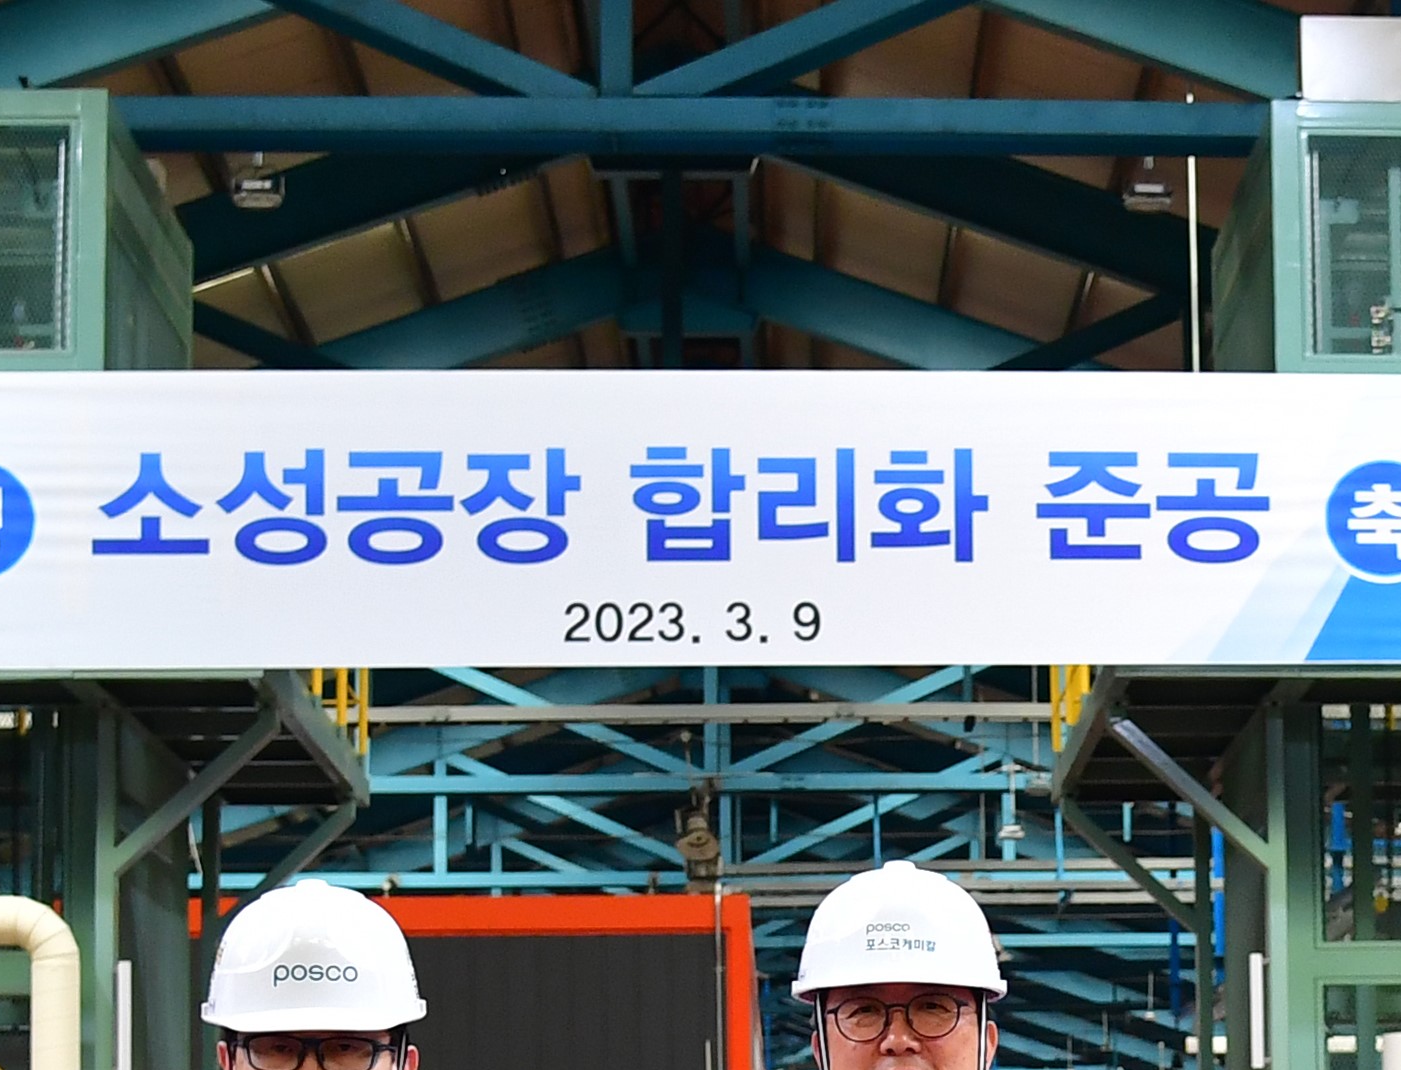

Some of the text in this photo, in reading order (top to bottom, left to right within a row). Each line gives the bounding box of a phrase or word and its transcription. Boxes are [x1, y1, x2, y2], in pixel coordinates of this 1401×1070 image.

[91, 447, 582, 565] 소성공장
[630, 446, 989, 562] 합리화
[1036, 450, 1271, 564] 준공
[563, 602, 822, 644] 2023. 3. 9
[866, 922, 911, 936] posco
[865, 937, 937, 952] 포스코케미칼
[273, 964, 359, 988] posco
